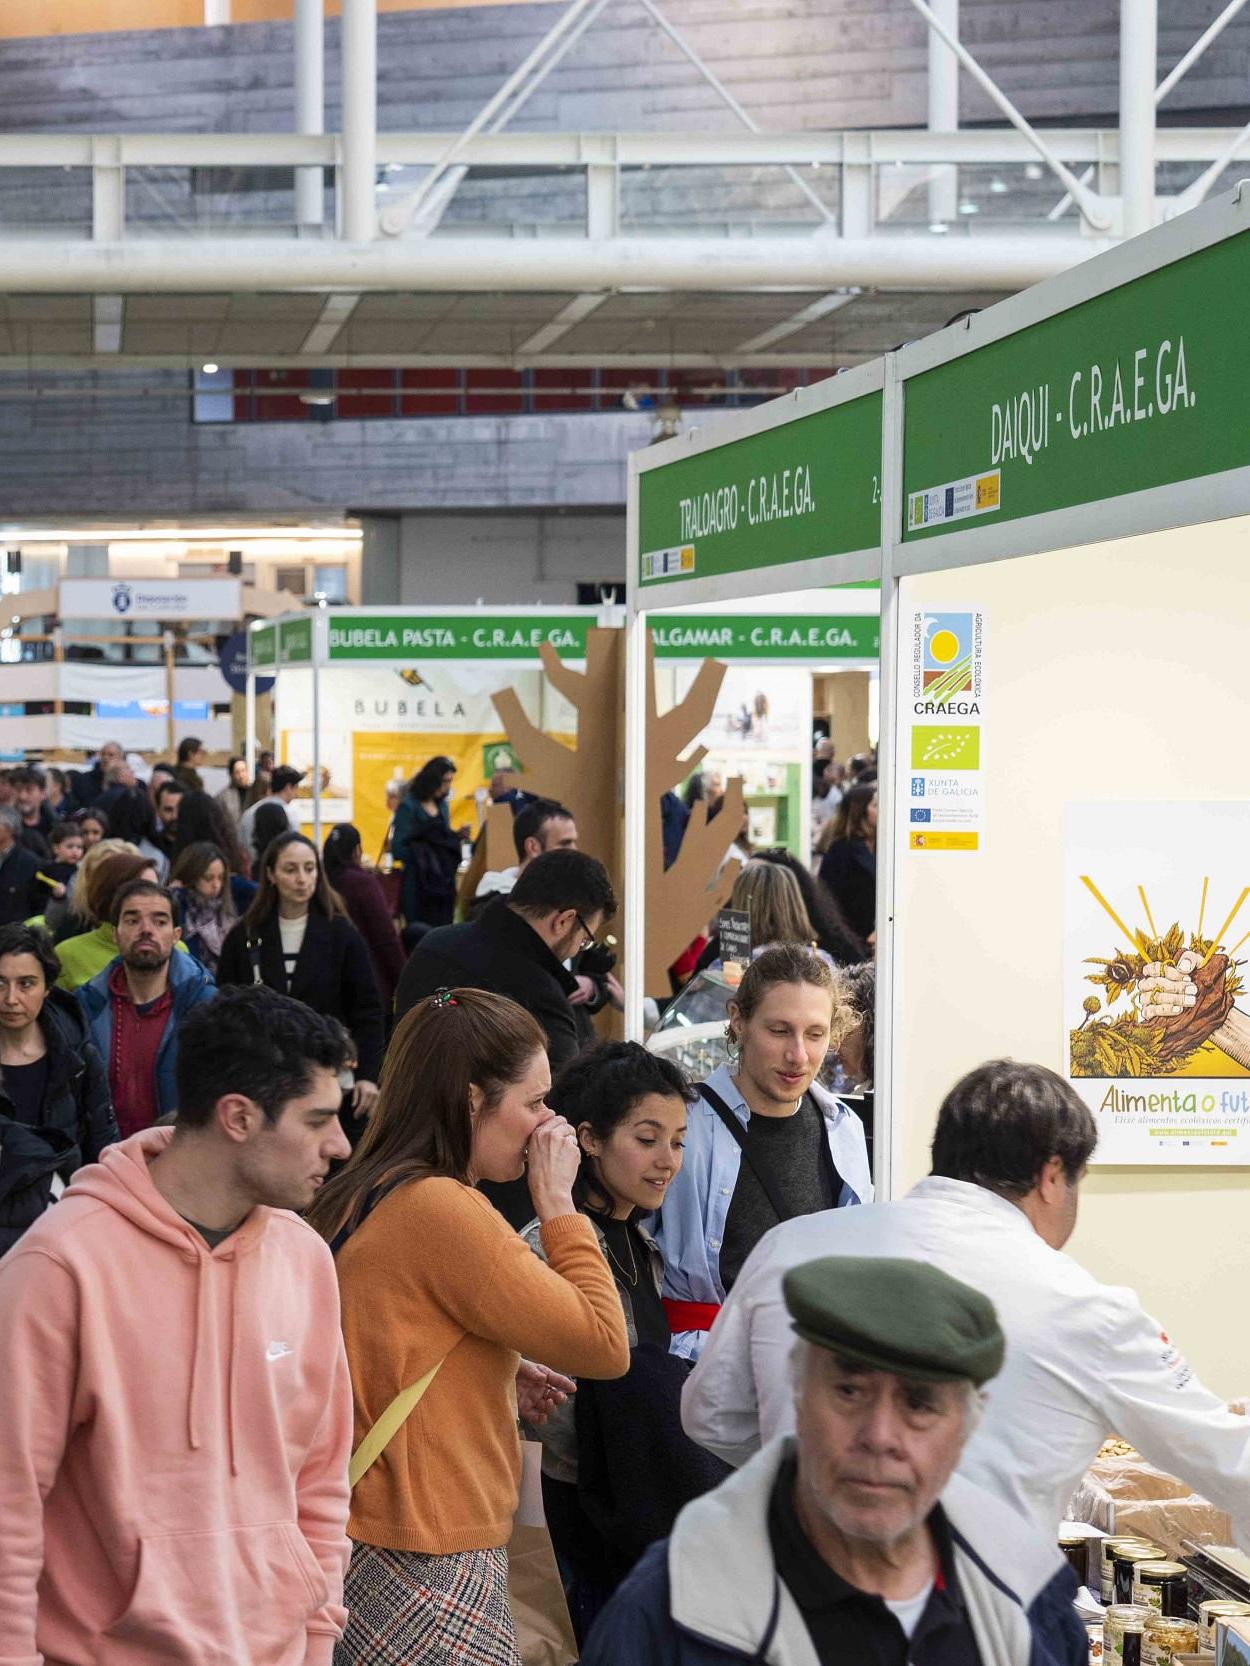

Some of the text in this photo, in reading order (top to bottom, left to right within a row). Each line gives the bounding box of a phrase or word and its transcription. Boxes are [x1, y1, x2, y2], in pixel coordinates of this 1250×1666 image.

[991, 384, 1049, 465] DAIQUI
[1069, 335, 1196, 439] C.R.A.E.GA.
[872, 476, 881, 504] 2-
[679, 484, 738, 541] TRALOAGRO
[748, 464, 815, 526] C.R.A.E.GA.
[329, 629, 399, 648] BUBELA
[402, 628, 456, 648] PASTA
[473, 628, 580, 649] C.R.A.EGA.
[750, 627, 858, 648] C.R.A.E.GA.
[354, 700, 466, 717] BUBELA
[914, 702, 980, 715] CRAEGA
[928, 779, 959, 787] XUNTA
[928, 788, 979, 796] DE GALICIA
[1100, 1084, 1197, 1113] Alimenta
[1201, 1093, 1215, 1113] o
[1138, 1115, 1177, 1124] alimentos
